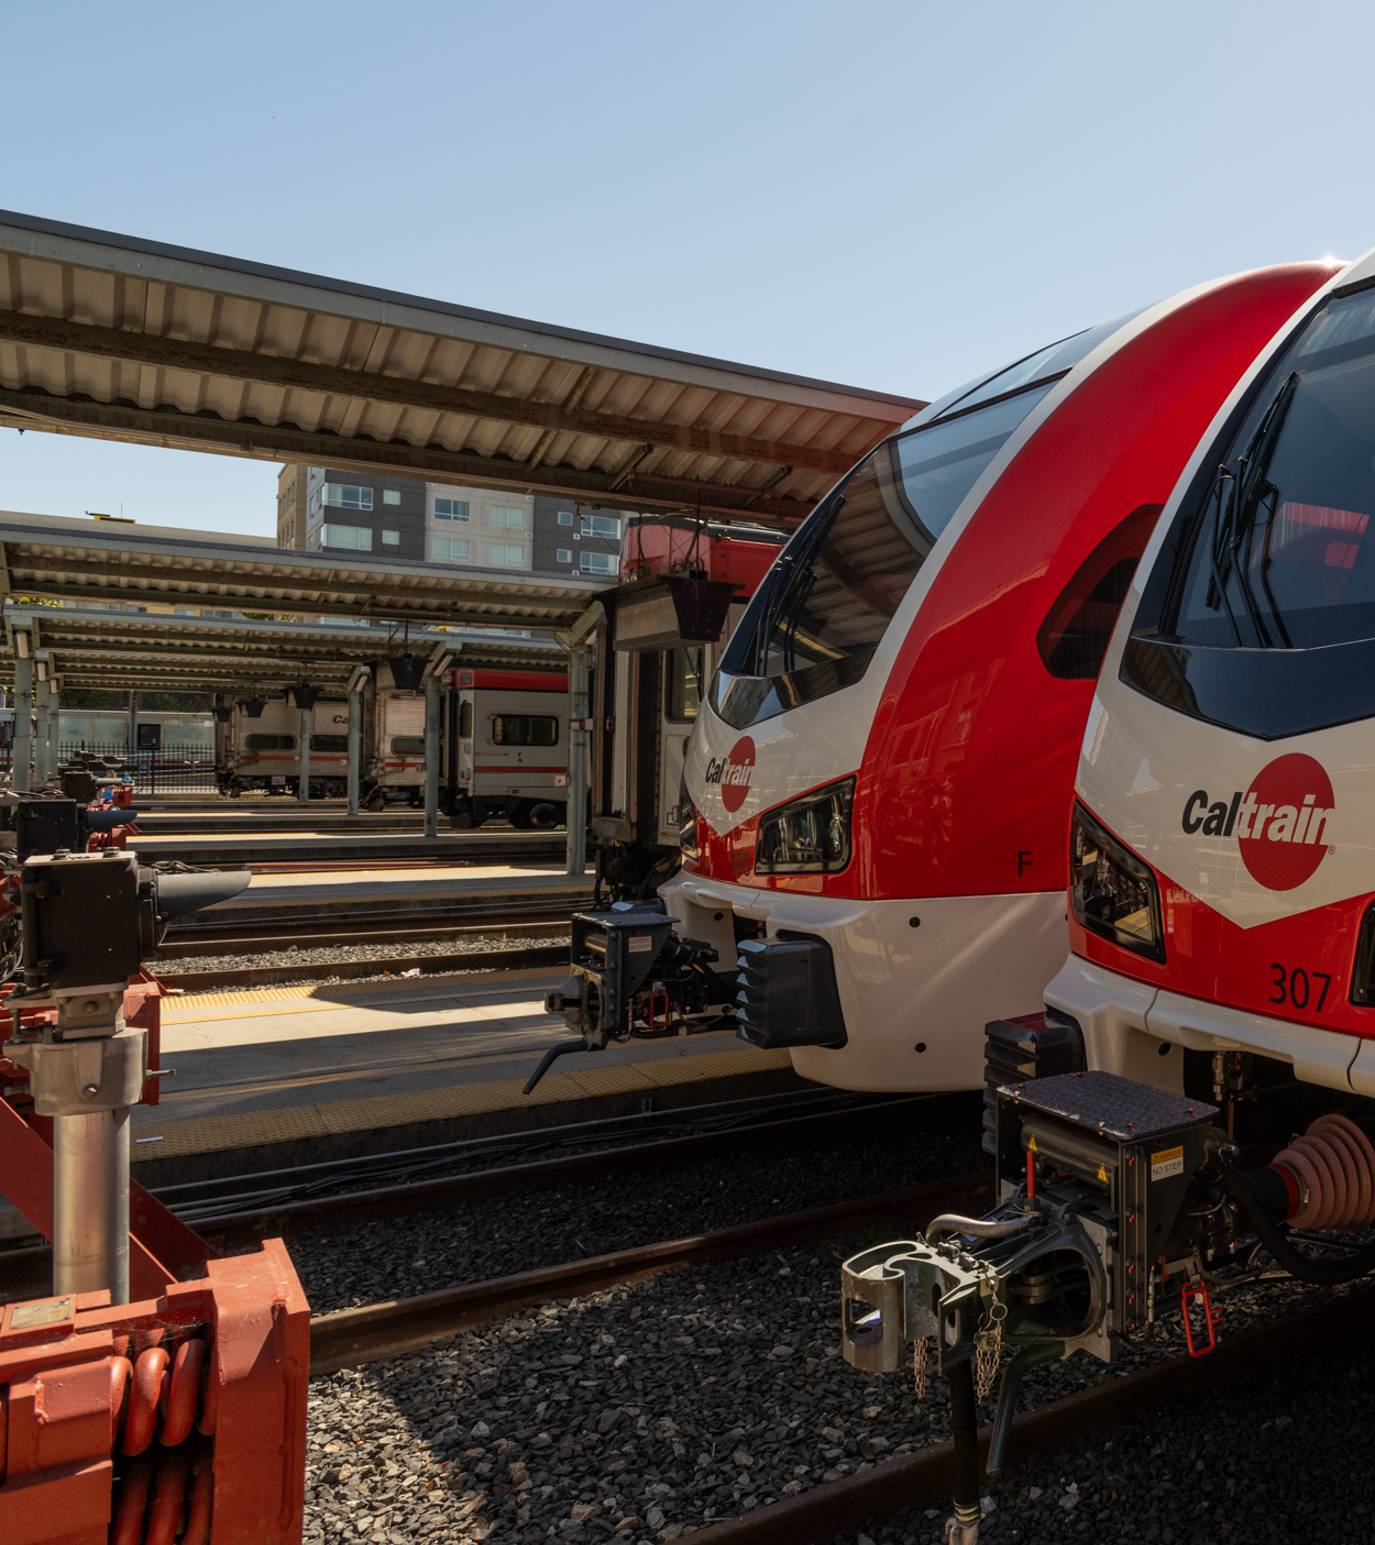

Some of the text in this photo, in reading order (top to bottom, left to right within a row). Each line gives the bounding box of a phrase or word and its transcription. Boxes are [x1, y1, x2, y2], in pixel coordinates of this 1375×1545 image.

[705, 757, 752, 787] Caltrain
[1181, 789, 1334, 846] Caltrain
[1017, 850, 1033, 877] F
[1269, 963, 1332, 1013] 307
